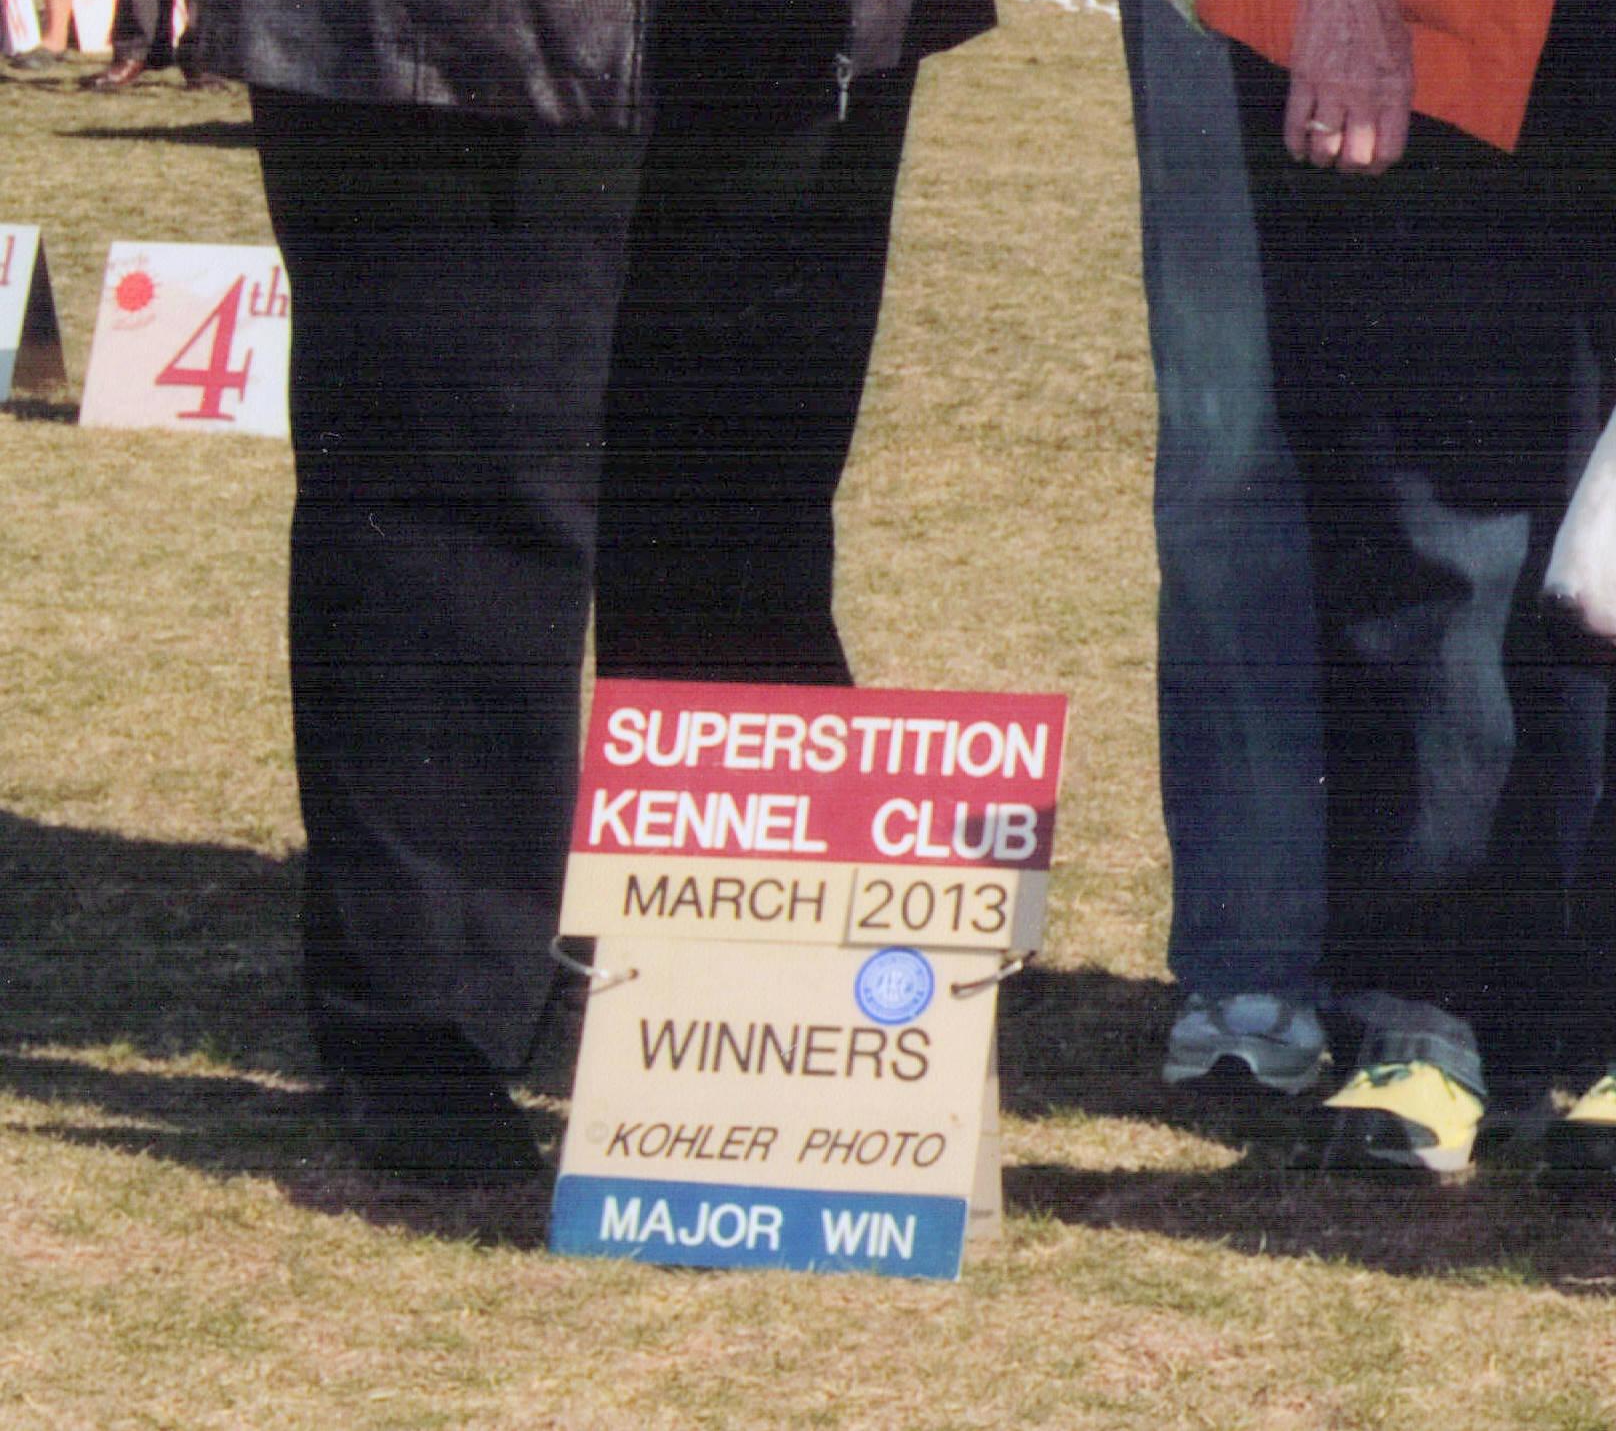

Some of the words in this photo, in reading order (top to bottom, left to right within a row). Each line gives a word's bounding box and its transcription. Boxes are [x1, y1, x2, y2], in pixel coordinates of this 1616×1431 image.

[603, 707, 1048, 778] SUPERSTITION
[588, 789, 827, 854] KENNEL
[870, 798, 1038, 862] CLUB
[622, 874, 826, 923] MARCH
[857, 880, 1008, 934] 2013
[640, 1018, 931, 1082] WINNERS
[606, 1122, 778, 1163] KOHLER
[799, 1130, 945, 1169] PHOTO
[600, 1197, 783, 1251] MAJOR
[821, 1209, 916, 1259] WIN
